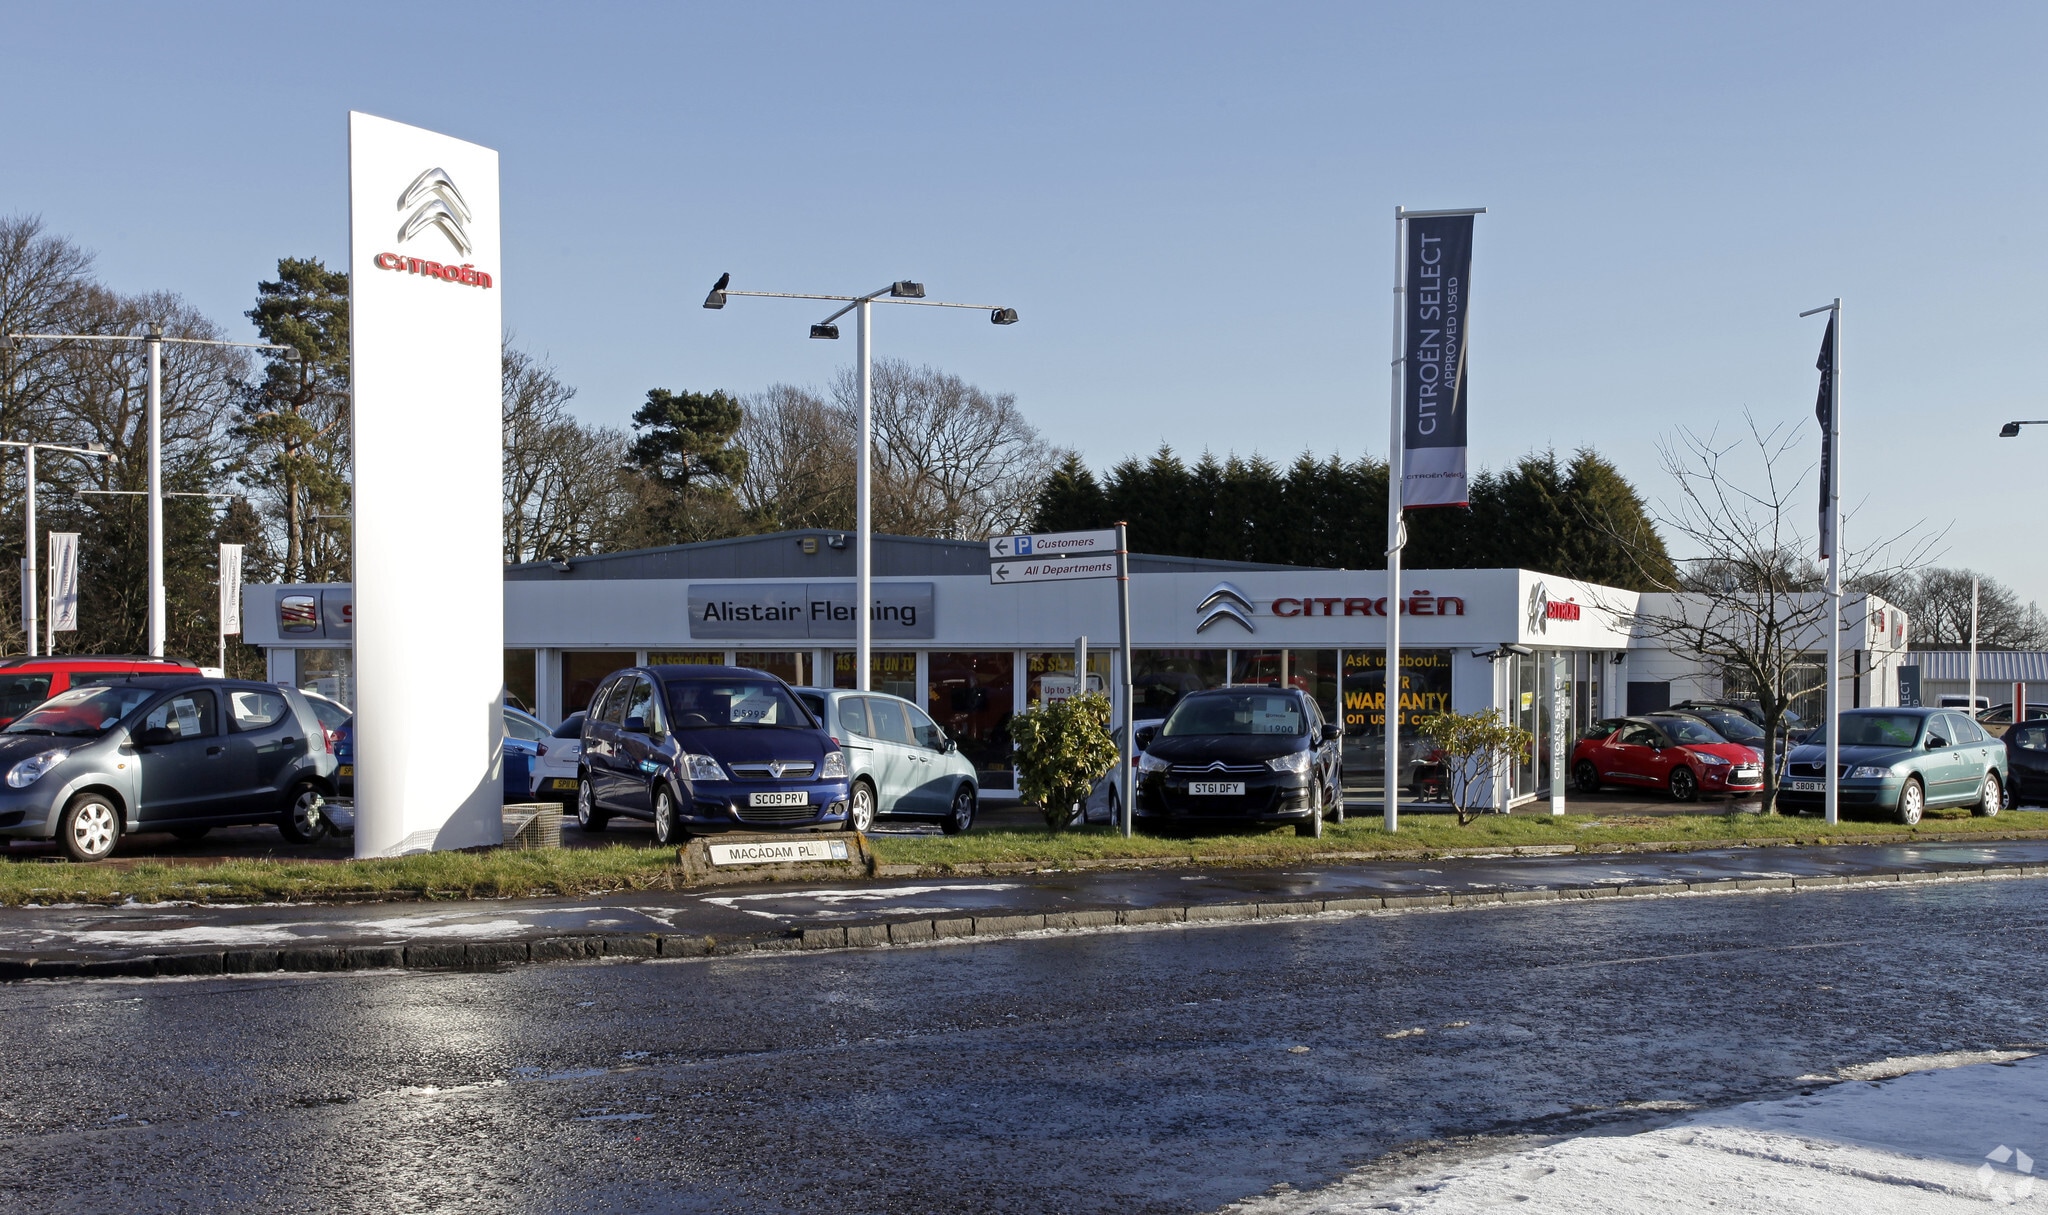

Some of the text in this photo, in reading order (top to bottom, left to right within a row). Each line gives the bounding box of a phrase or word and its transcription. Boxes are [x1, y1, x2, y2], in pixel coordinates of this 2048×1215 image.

[1417, 233, 1441, 435] CITROËN SELECT
[1444, 277, 1458, 389] APPROVED USED
[1036, 538, 1095, 549] Customers
[1024, 563, 1112, 576] All Departments
[1271, 589, 1465, 617] CITROËN
[702, 601, 801, 622] Alistair
[836, 656, 850, 671] AS
[883, 656, 899, 671] ON
[902, 656, 915, 671] TV
[1029, 657, 1044, 672] AS
[1345, 654, 1371, 667] Ask
[1044, 686, 1055, 695] Up
[1056, 686, 1065, 694] to
[1066, 686, 1071, 694] 3
[1900, 680, 1911, 707] LECT
[1344, 692, 1449, 710] WARANTY
[1346, 713, 1365, 725] on
[1370, 711, 1406, 725] usd
[1195, 783, 1239, 793] ST61 DFY
[1795, 782, 1827, 791] SB08 TX
[755, 793, 804, 805] SC09 PRV
[729, 846, 793, 860] MACADAM
